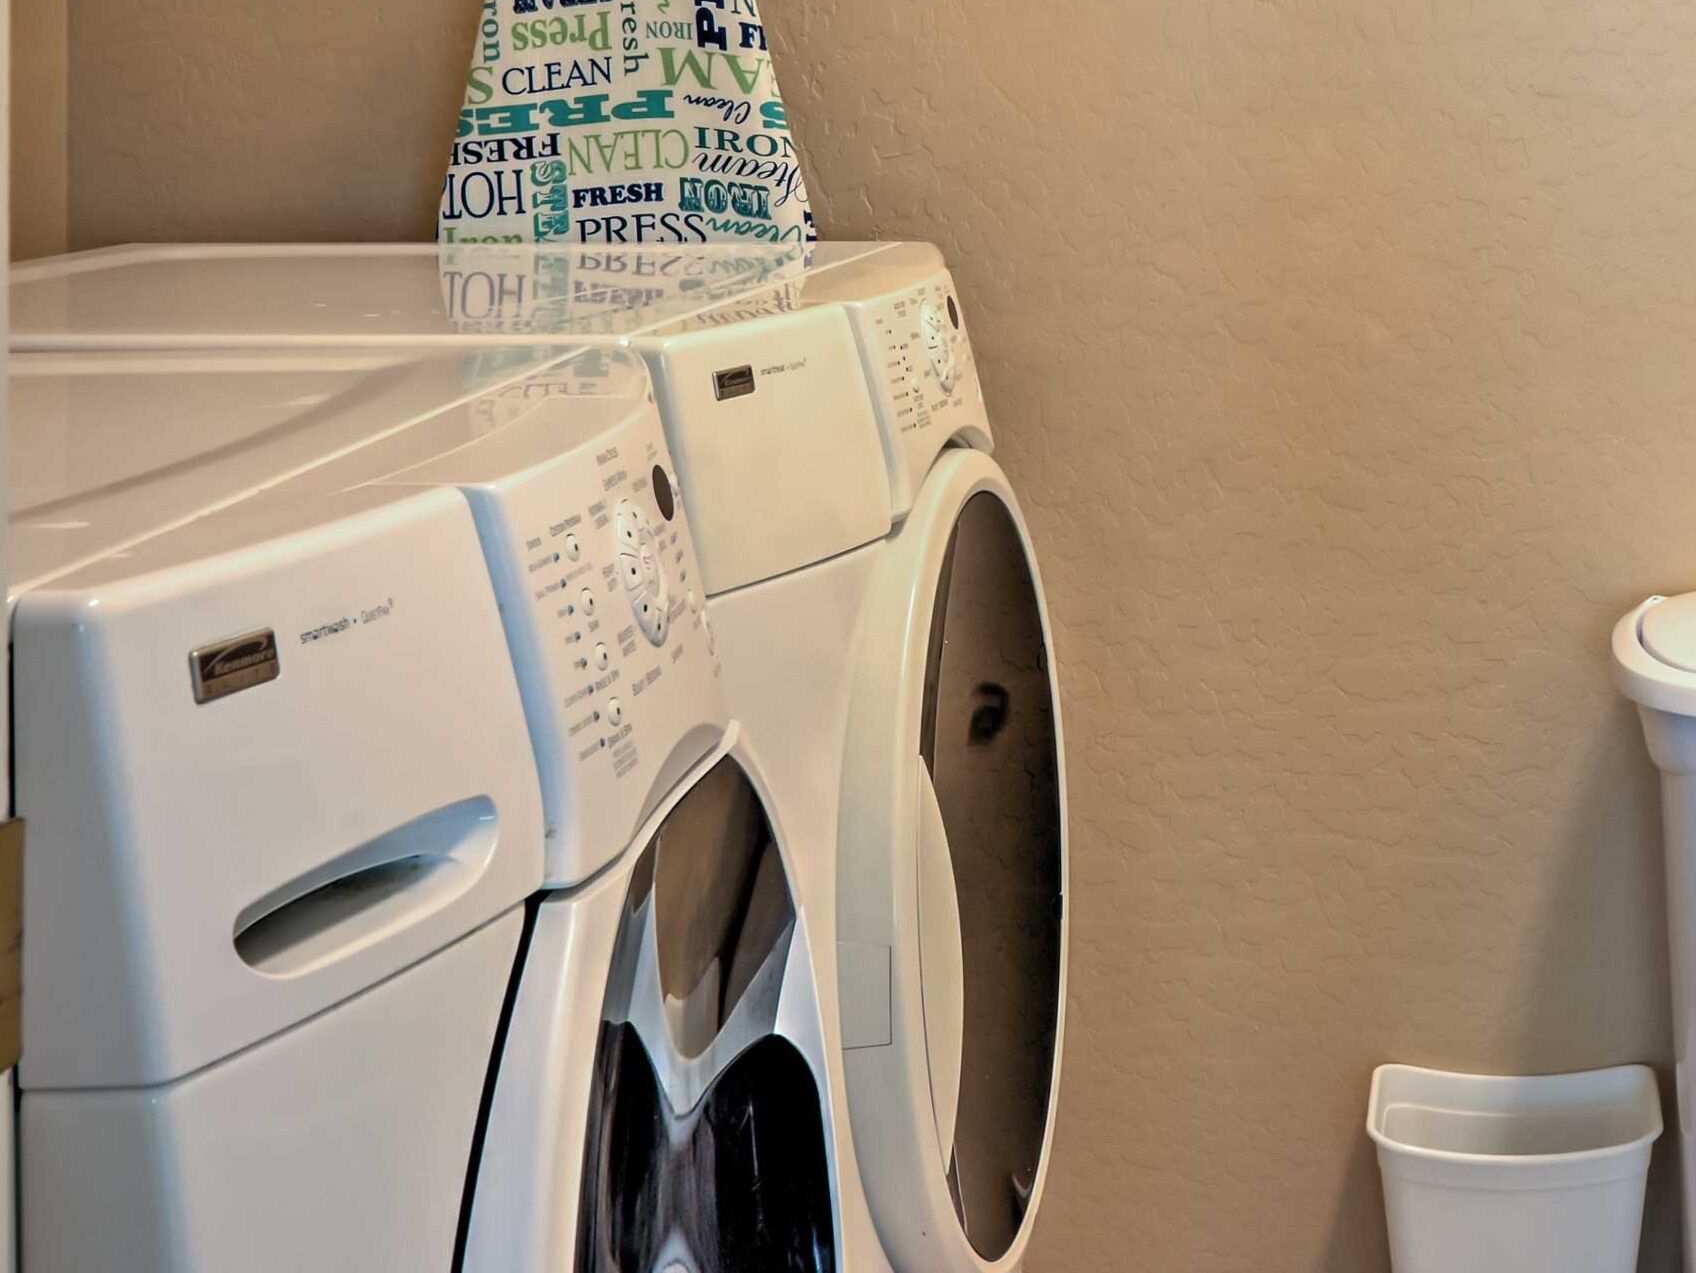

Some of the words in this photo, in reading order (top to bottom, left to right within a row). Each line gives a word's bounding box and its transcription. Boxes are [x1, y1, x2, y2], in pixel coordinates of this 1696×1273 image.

[511, 11, 612, 51] Press
[646, 21, 692, 40] IRON
[502, 57, 612, 95] CLEAN
[568, 129, 690, 176] CLEAN
[442, 169, 526, 220] HOT
[573, 182, 664, 208] FRESH
[679, 177, 772, 220] IRON
